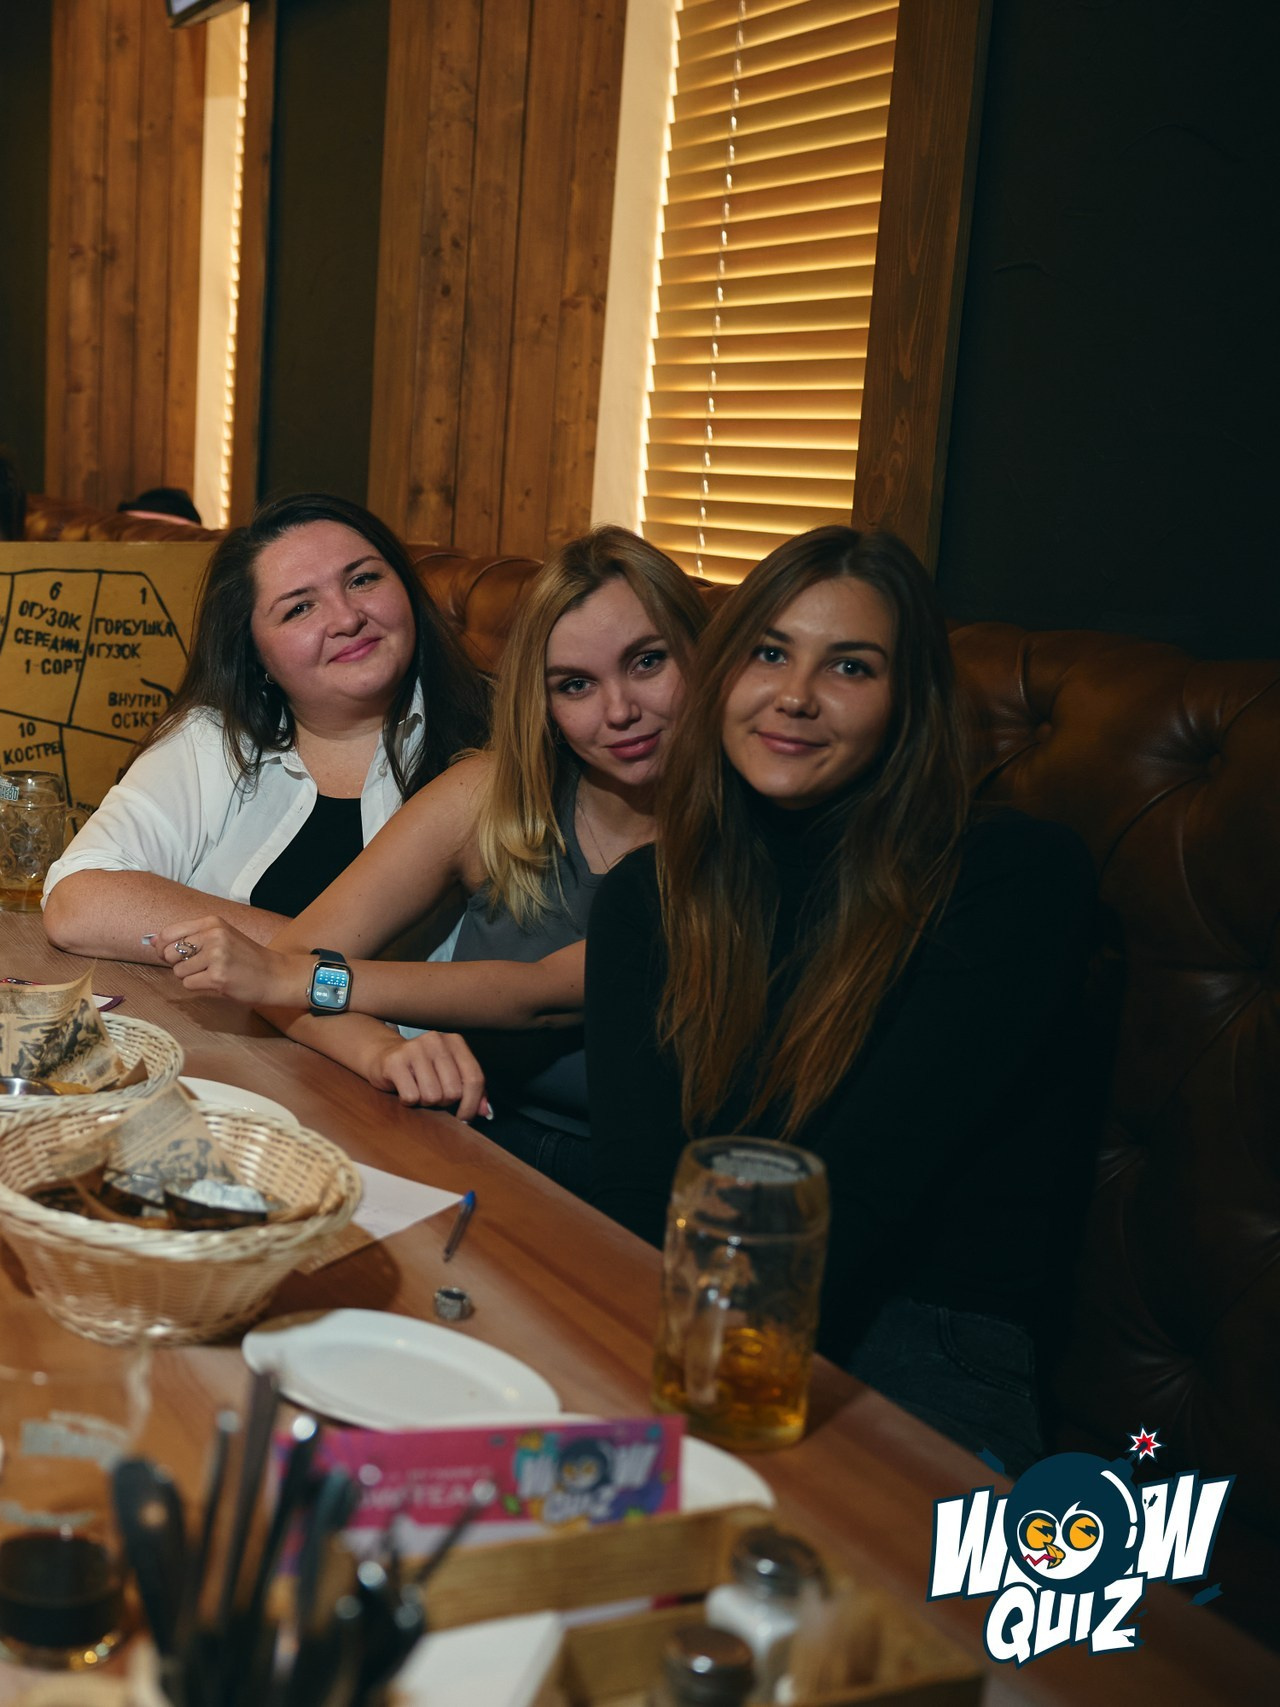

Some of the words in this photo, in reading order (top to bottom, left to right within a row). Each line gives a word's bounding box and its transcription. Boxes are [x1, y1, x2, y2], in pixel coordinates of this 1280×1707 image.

[49, 581, 63, 600] 6
[139, 587, 147, 605] 1
[18, 600, 82, 632] ОГУЗОК
[94, 617, 175, 637] ГОРБУШКА
[108, 692, 162, 708] ВНУТРИ
[18, 721, 36, 738] 10
